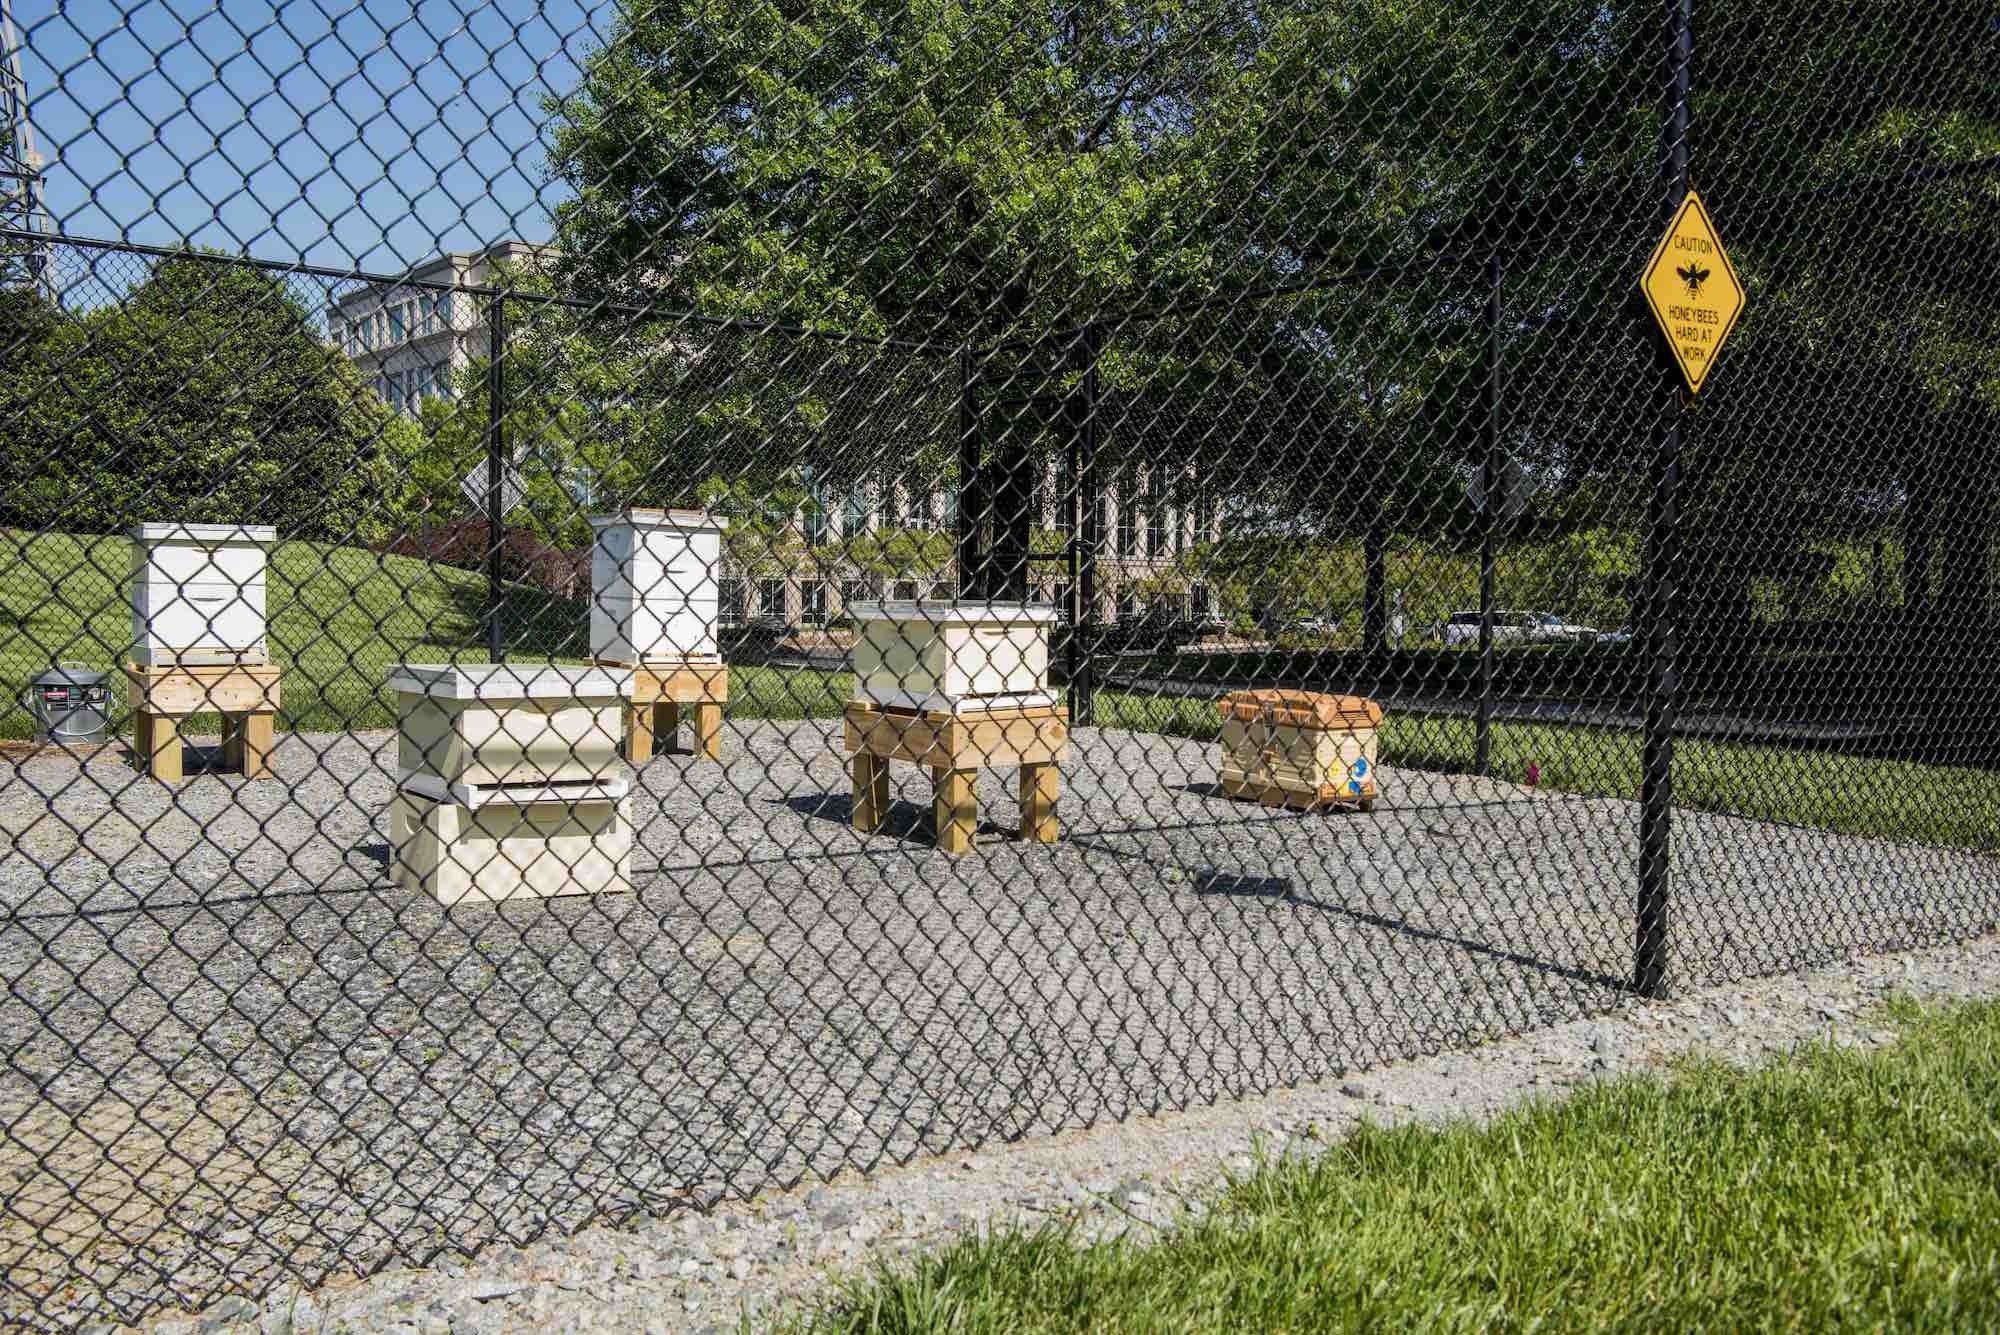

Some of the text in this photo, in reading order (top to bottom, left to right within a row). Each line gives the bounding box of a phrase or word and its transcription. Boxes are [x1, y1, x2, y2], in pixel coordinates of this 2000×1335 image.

[1674, 235, 1712, 254] CAUTION
[1669, 305, 1719, 325] HONEYBEES
[1676, 327, 1712, 343] HARD AT
[1683, 348, 1706, 362] WORK
